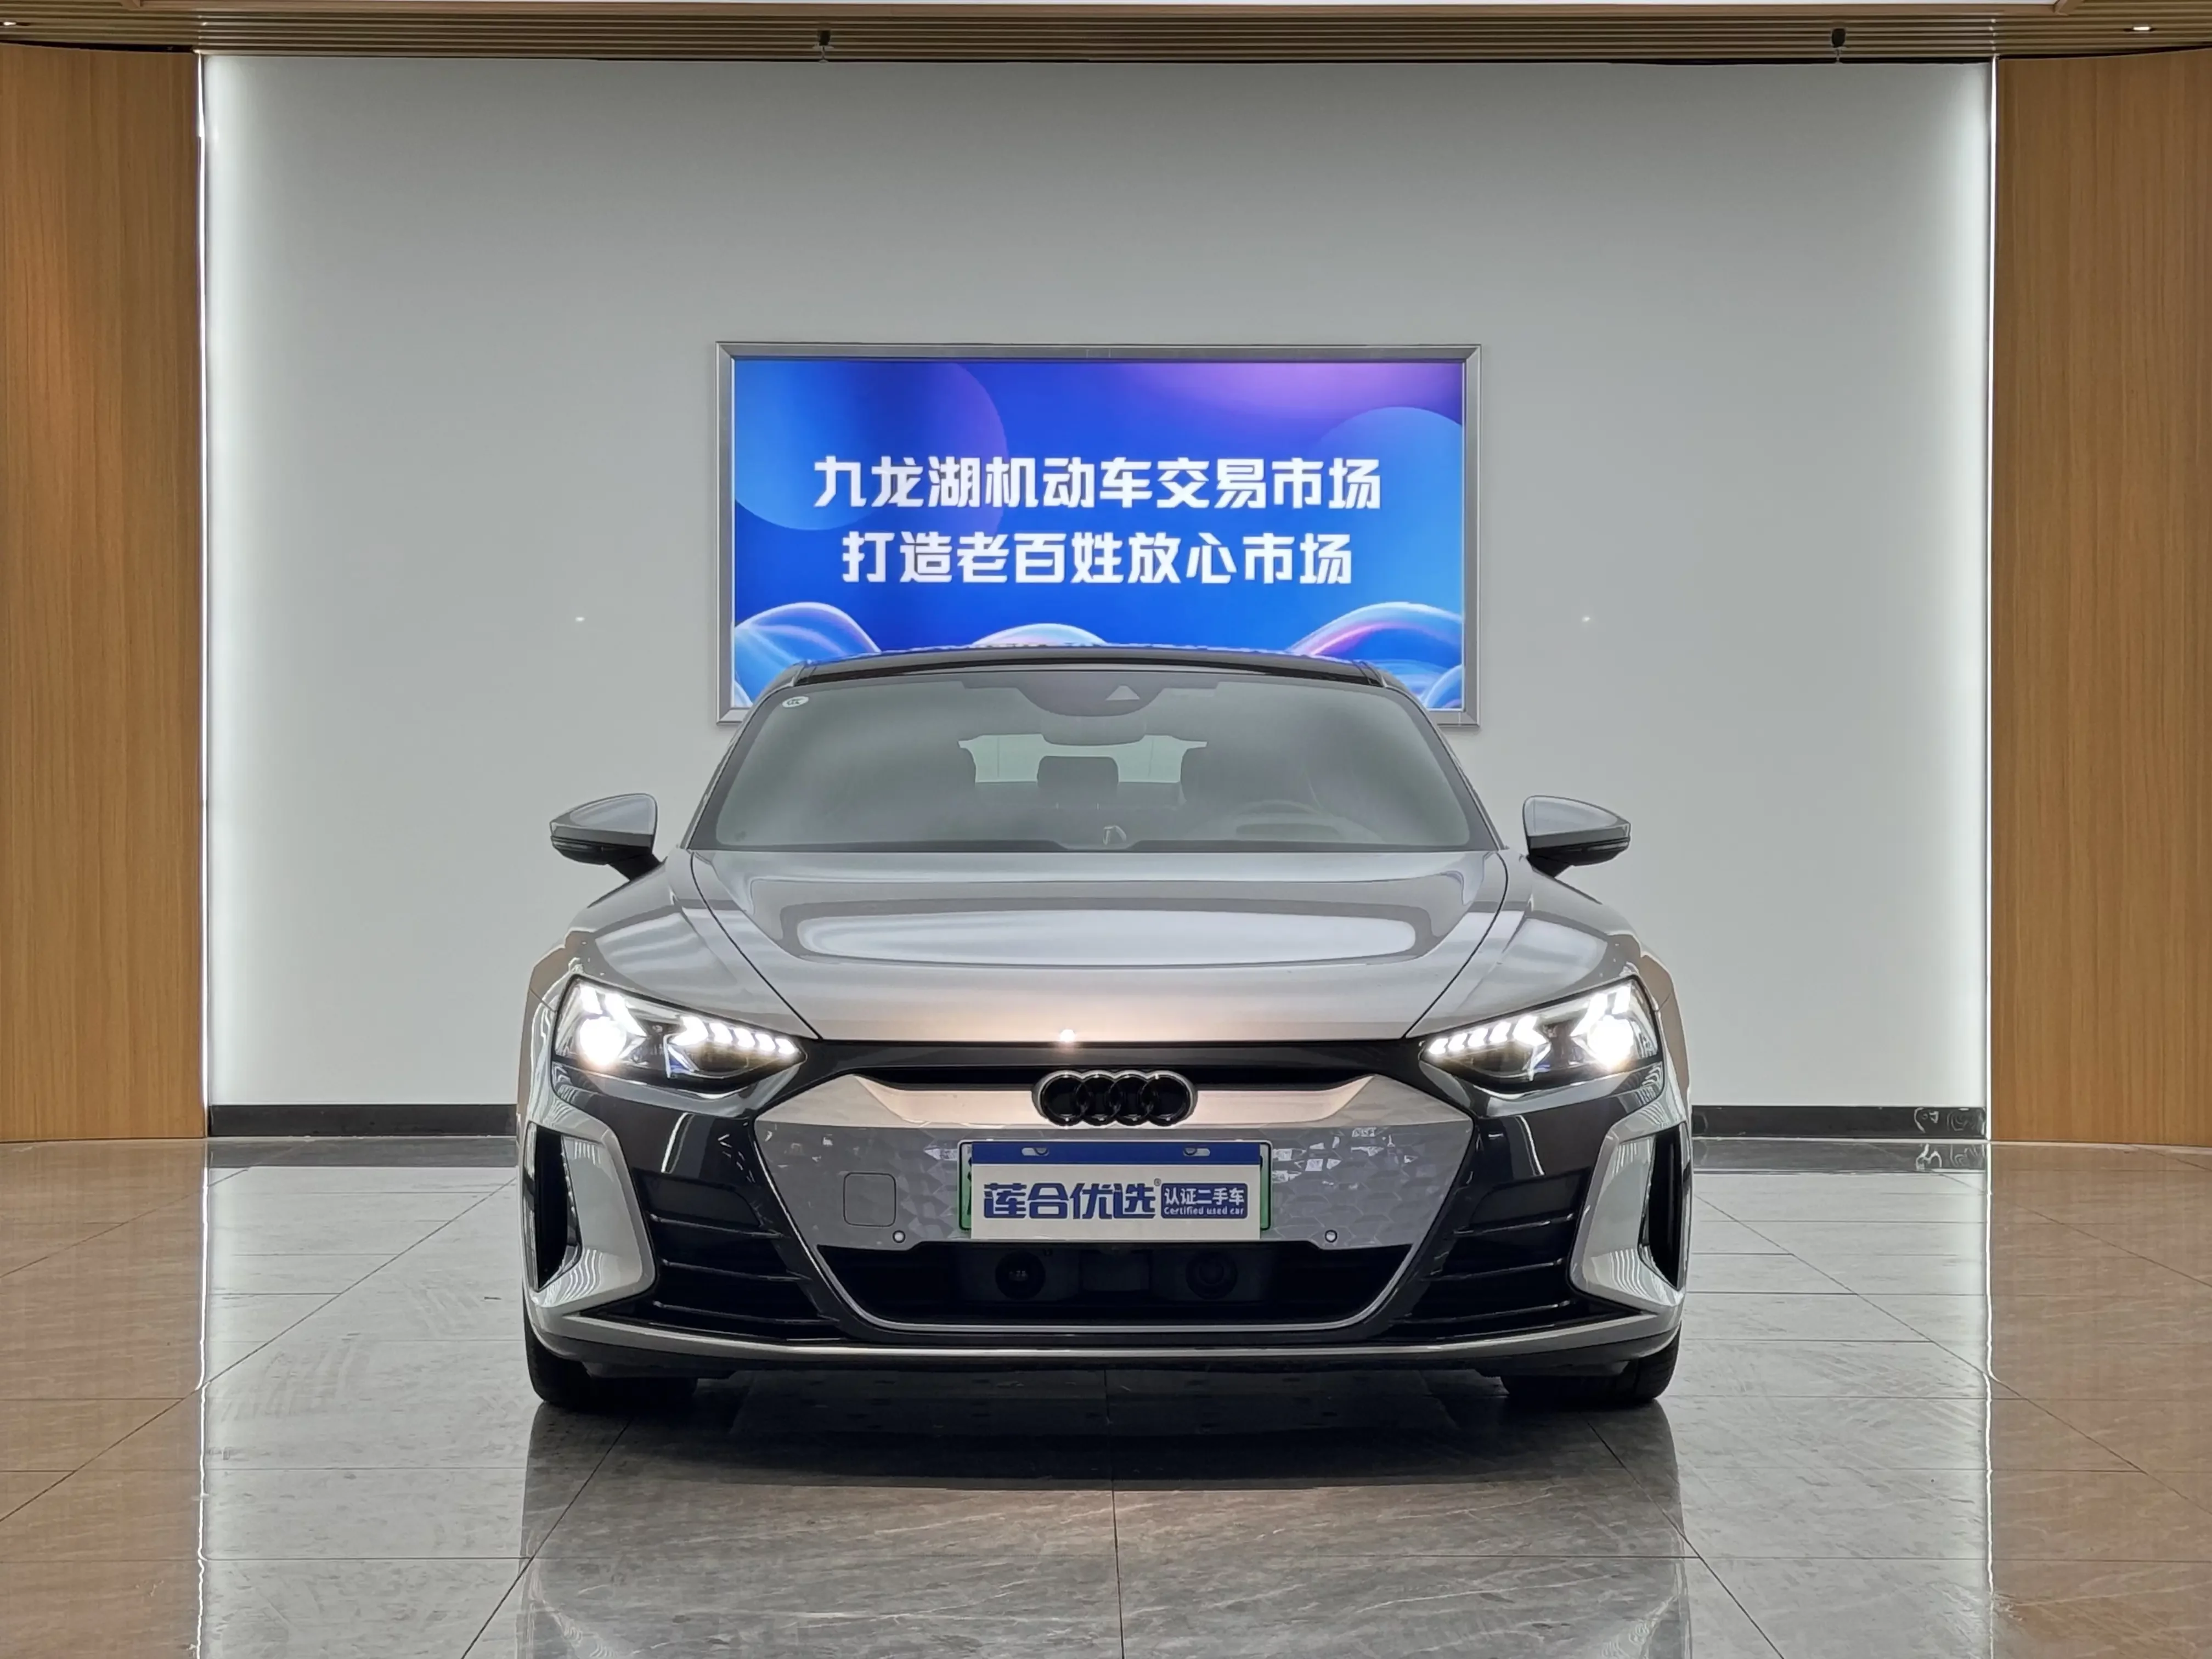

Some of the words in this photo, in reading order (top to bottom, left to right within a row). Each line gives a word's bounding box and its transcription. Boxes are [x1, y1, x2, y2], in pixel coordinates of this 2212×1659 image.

[815, 456, 1380, 509] 九龙湖机动车交易市场
[843, 531, 1351, 584] 打造老百姓放心市场
[984, 1183, 1156, 1219] 莲合优选
[1164, 1187, 1244, 1205] 认证二手车
[1164, 1206, 1204, 1215] Certified
[1206, 1206, 1228, 1215] used
[1229, 1207, 1244, 1215] car
